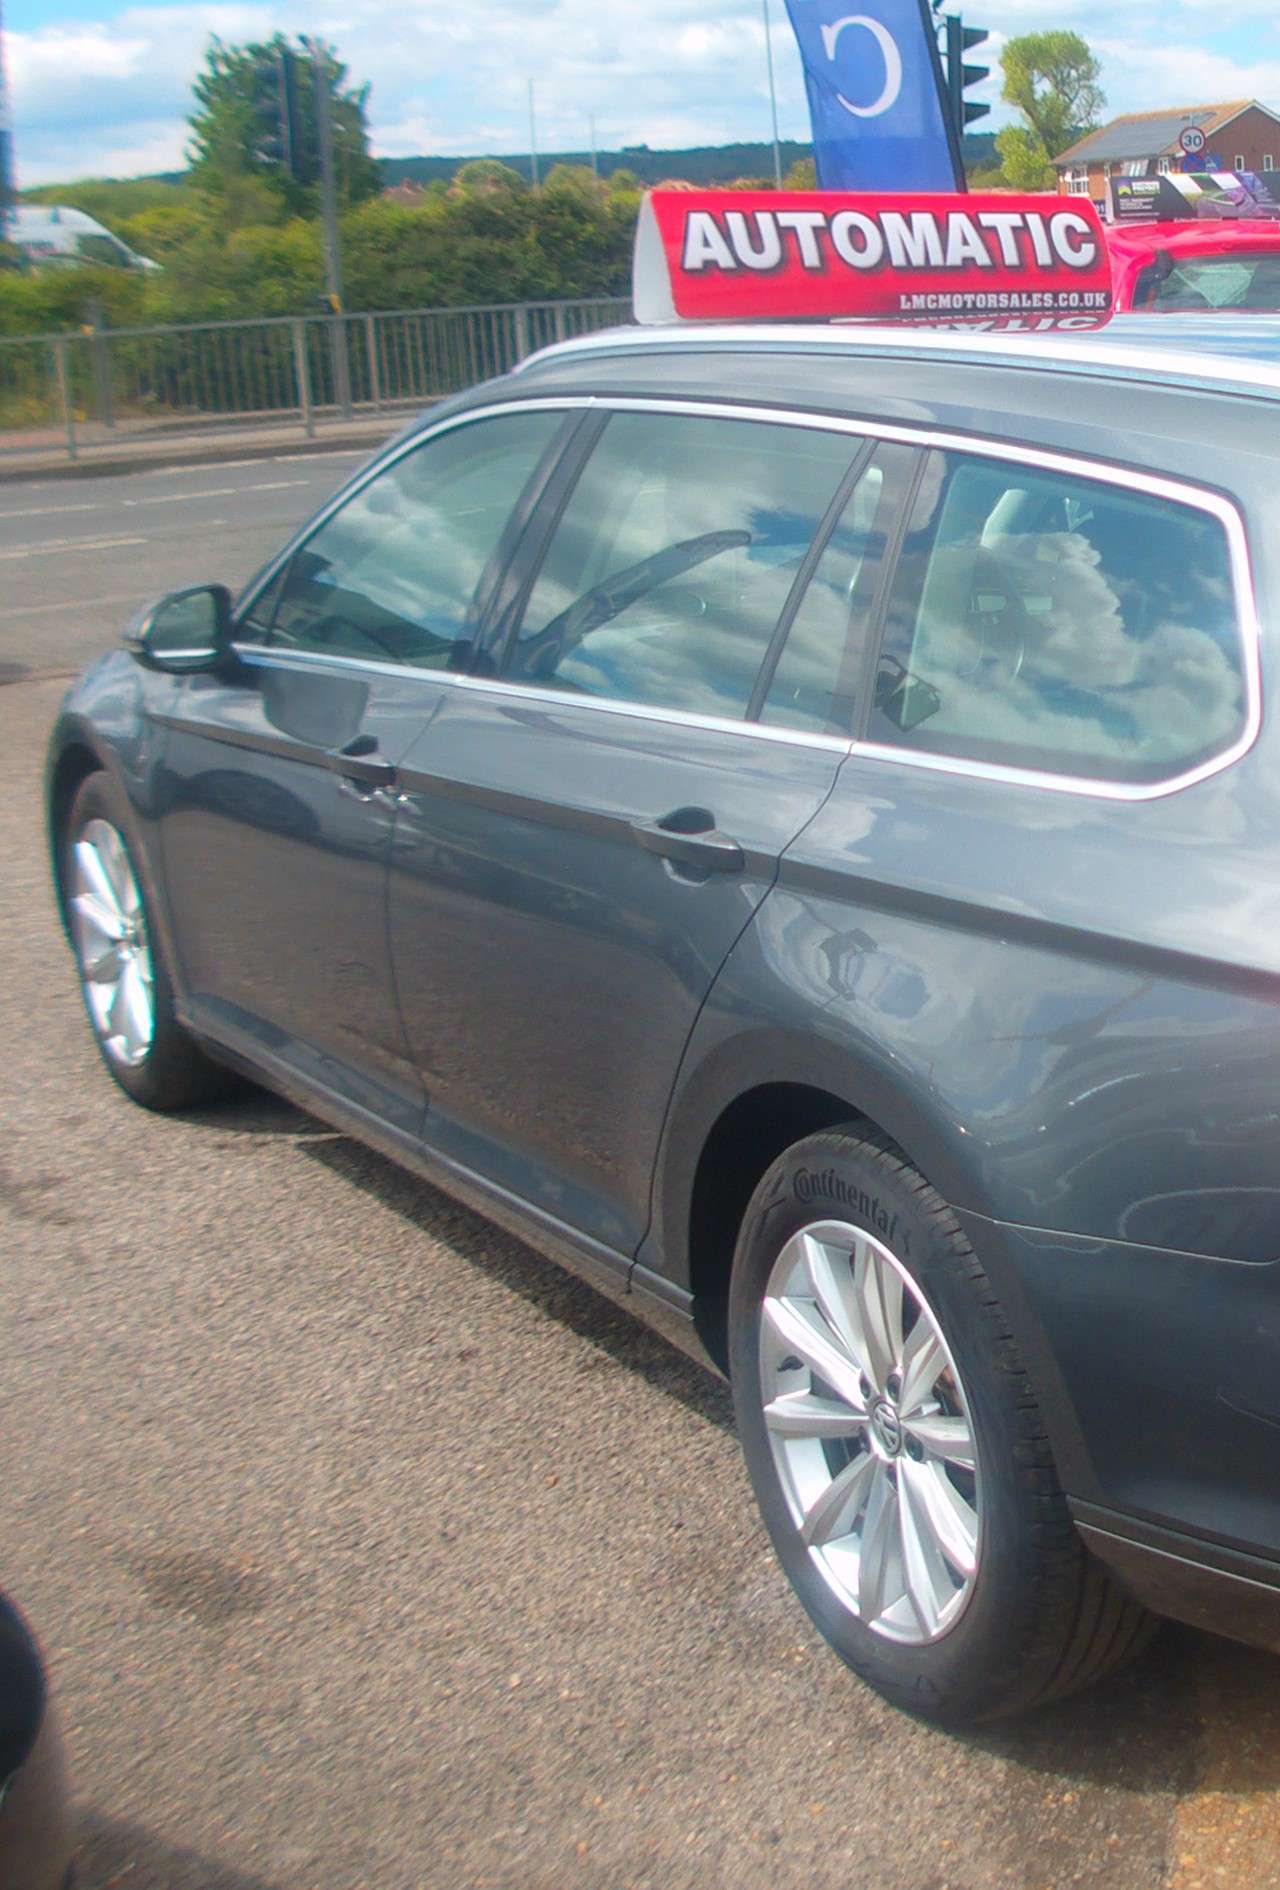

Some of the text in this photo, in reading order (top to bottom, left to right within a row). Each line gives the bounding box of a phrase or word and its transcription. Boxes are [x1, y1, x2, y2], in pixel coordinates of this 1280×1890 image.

[1183, 135, 1202, 147] 30
[683, 211, 1097, 270] AUTOMATIC
[900, 292, 1106, 310] LMCMOTORSALES.CO.UK
[793, 1167, 897, 1241] Continental
